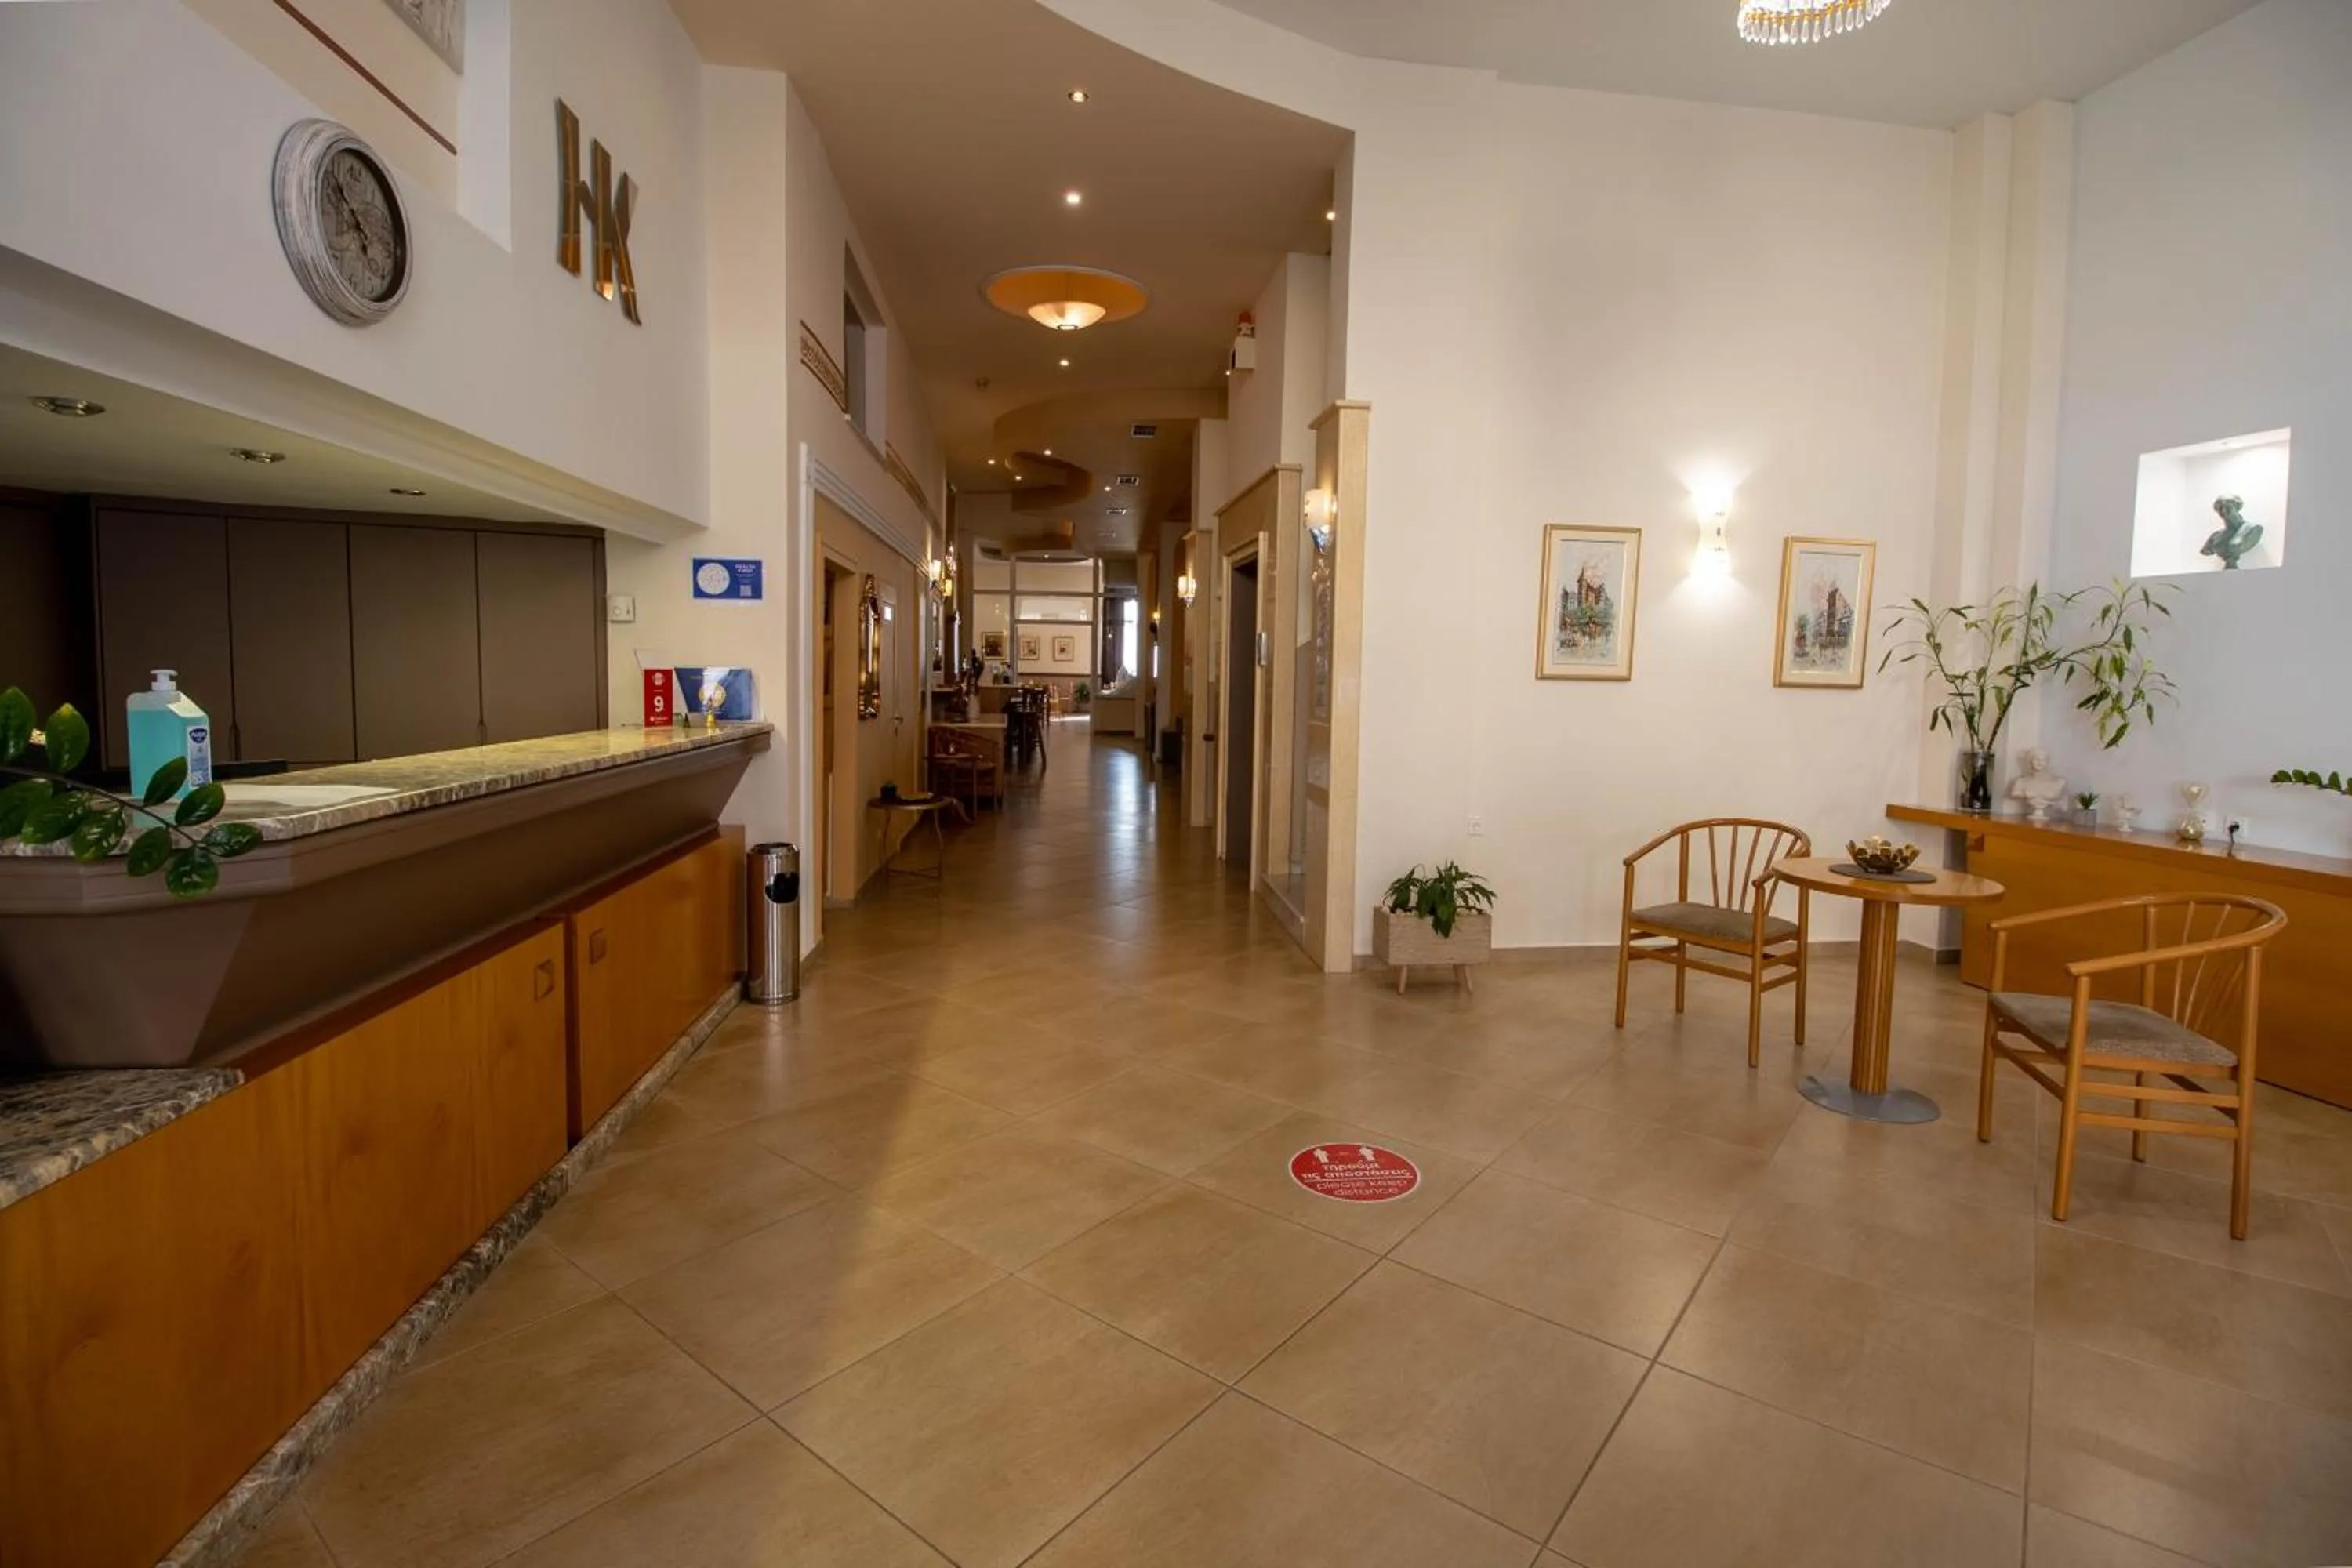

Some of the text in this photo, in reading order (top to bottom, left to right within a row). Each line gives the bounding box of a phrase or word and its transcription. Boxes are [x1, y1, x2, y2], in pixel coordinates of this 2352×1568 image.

[653, 695, 665, 713] 9
[1316, 1179, 1407, 1190] please keep
